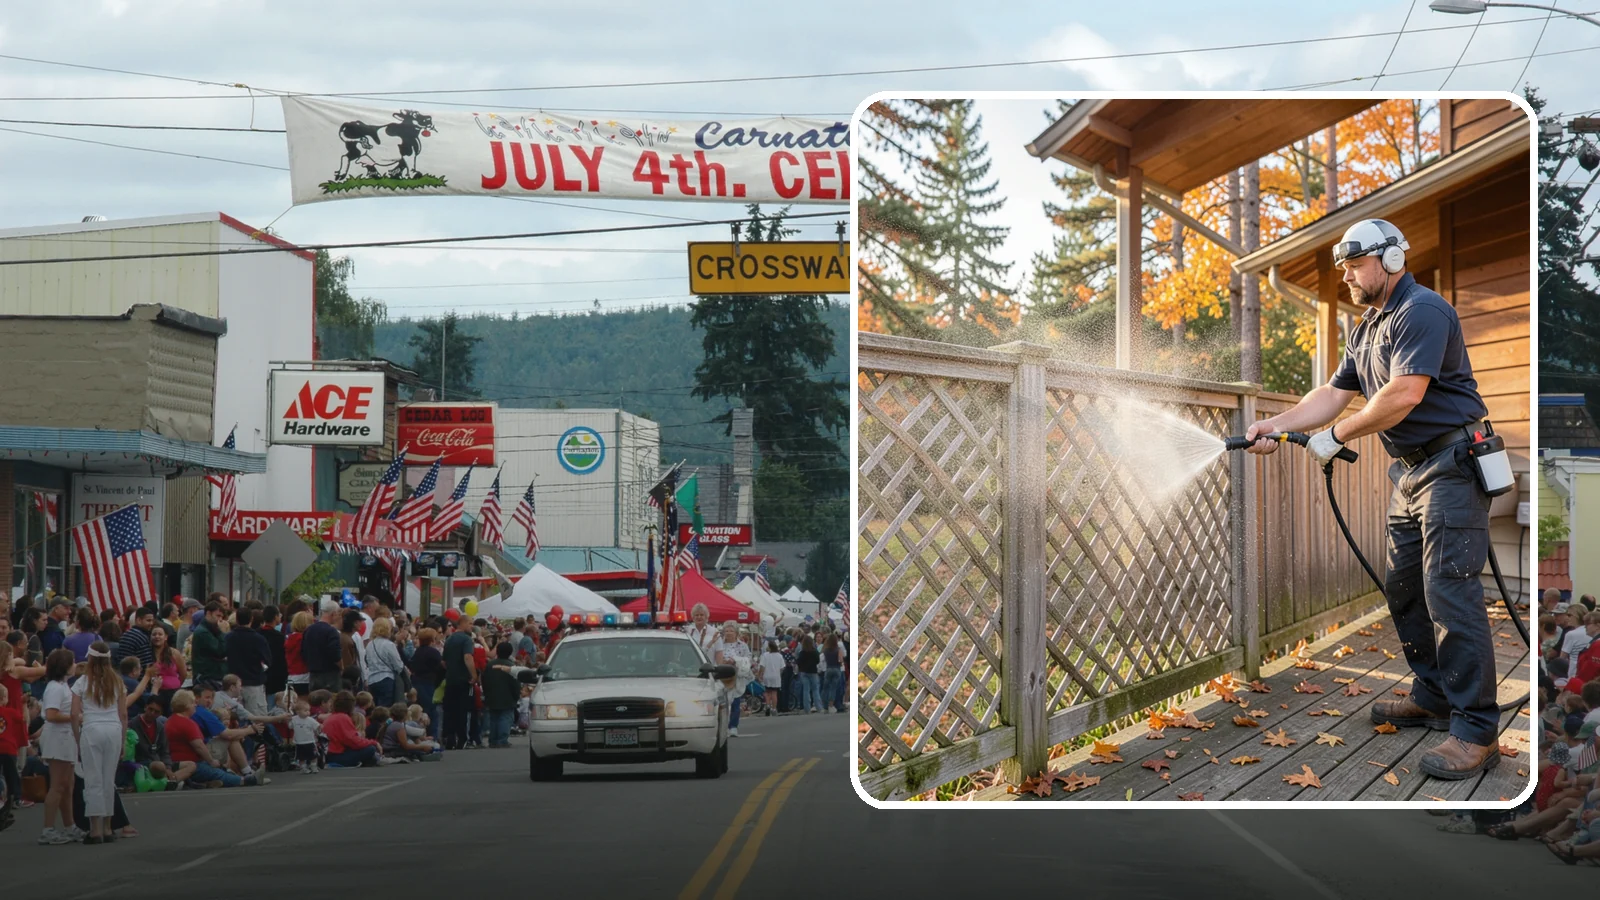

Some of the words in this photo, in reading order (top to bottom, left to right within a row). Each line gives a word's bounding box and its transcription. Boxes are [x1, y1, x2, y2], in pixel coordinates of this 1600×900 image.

[694, 120, 850, 150] Carnat
[481, 140, 605, 192] JULY
[632, 150, 746, 198] 4th.
[696, 254, 850, 280] CROSSWA
[282, 379, 374, 420] ACE
[405, 409, 453, 422] CEDAR
[283, 421, 371, 437] Hardware
[353, 467, 384, 480] Simpl
[95, 485, 124, 495] Vincent
[126, 486, 136, 495] de
[137, 486, 156, 496] Paul
[688, 526, 741, 535] CRNATION
[699, 535, 730, 543] GLASS
